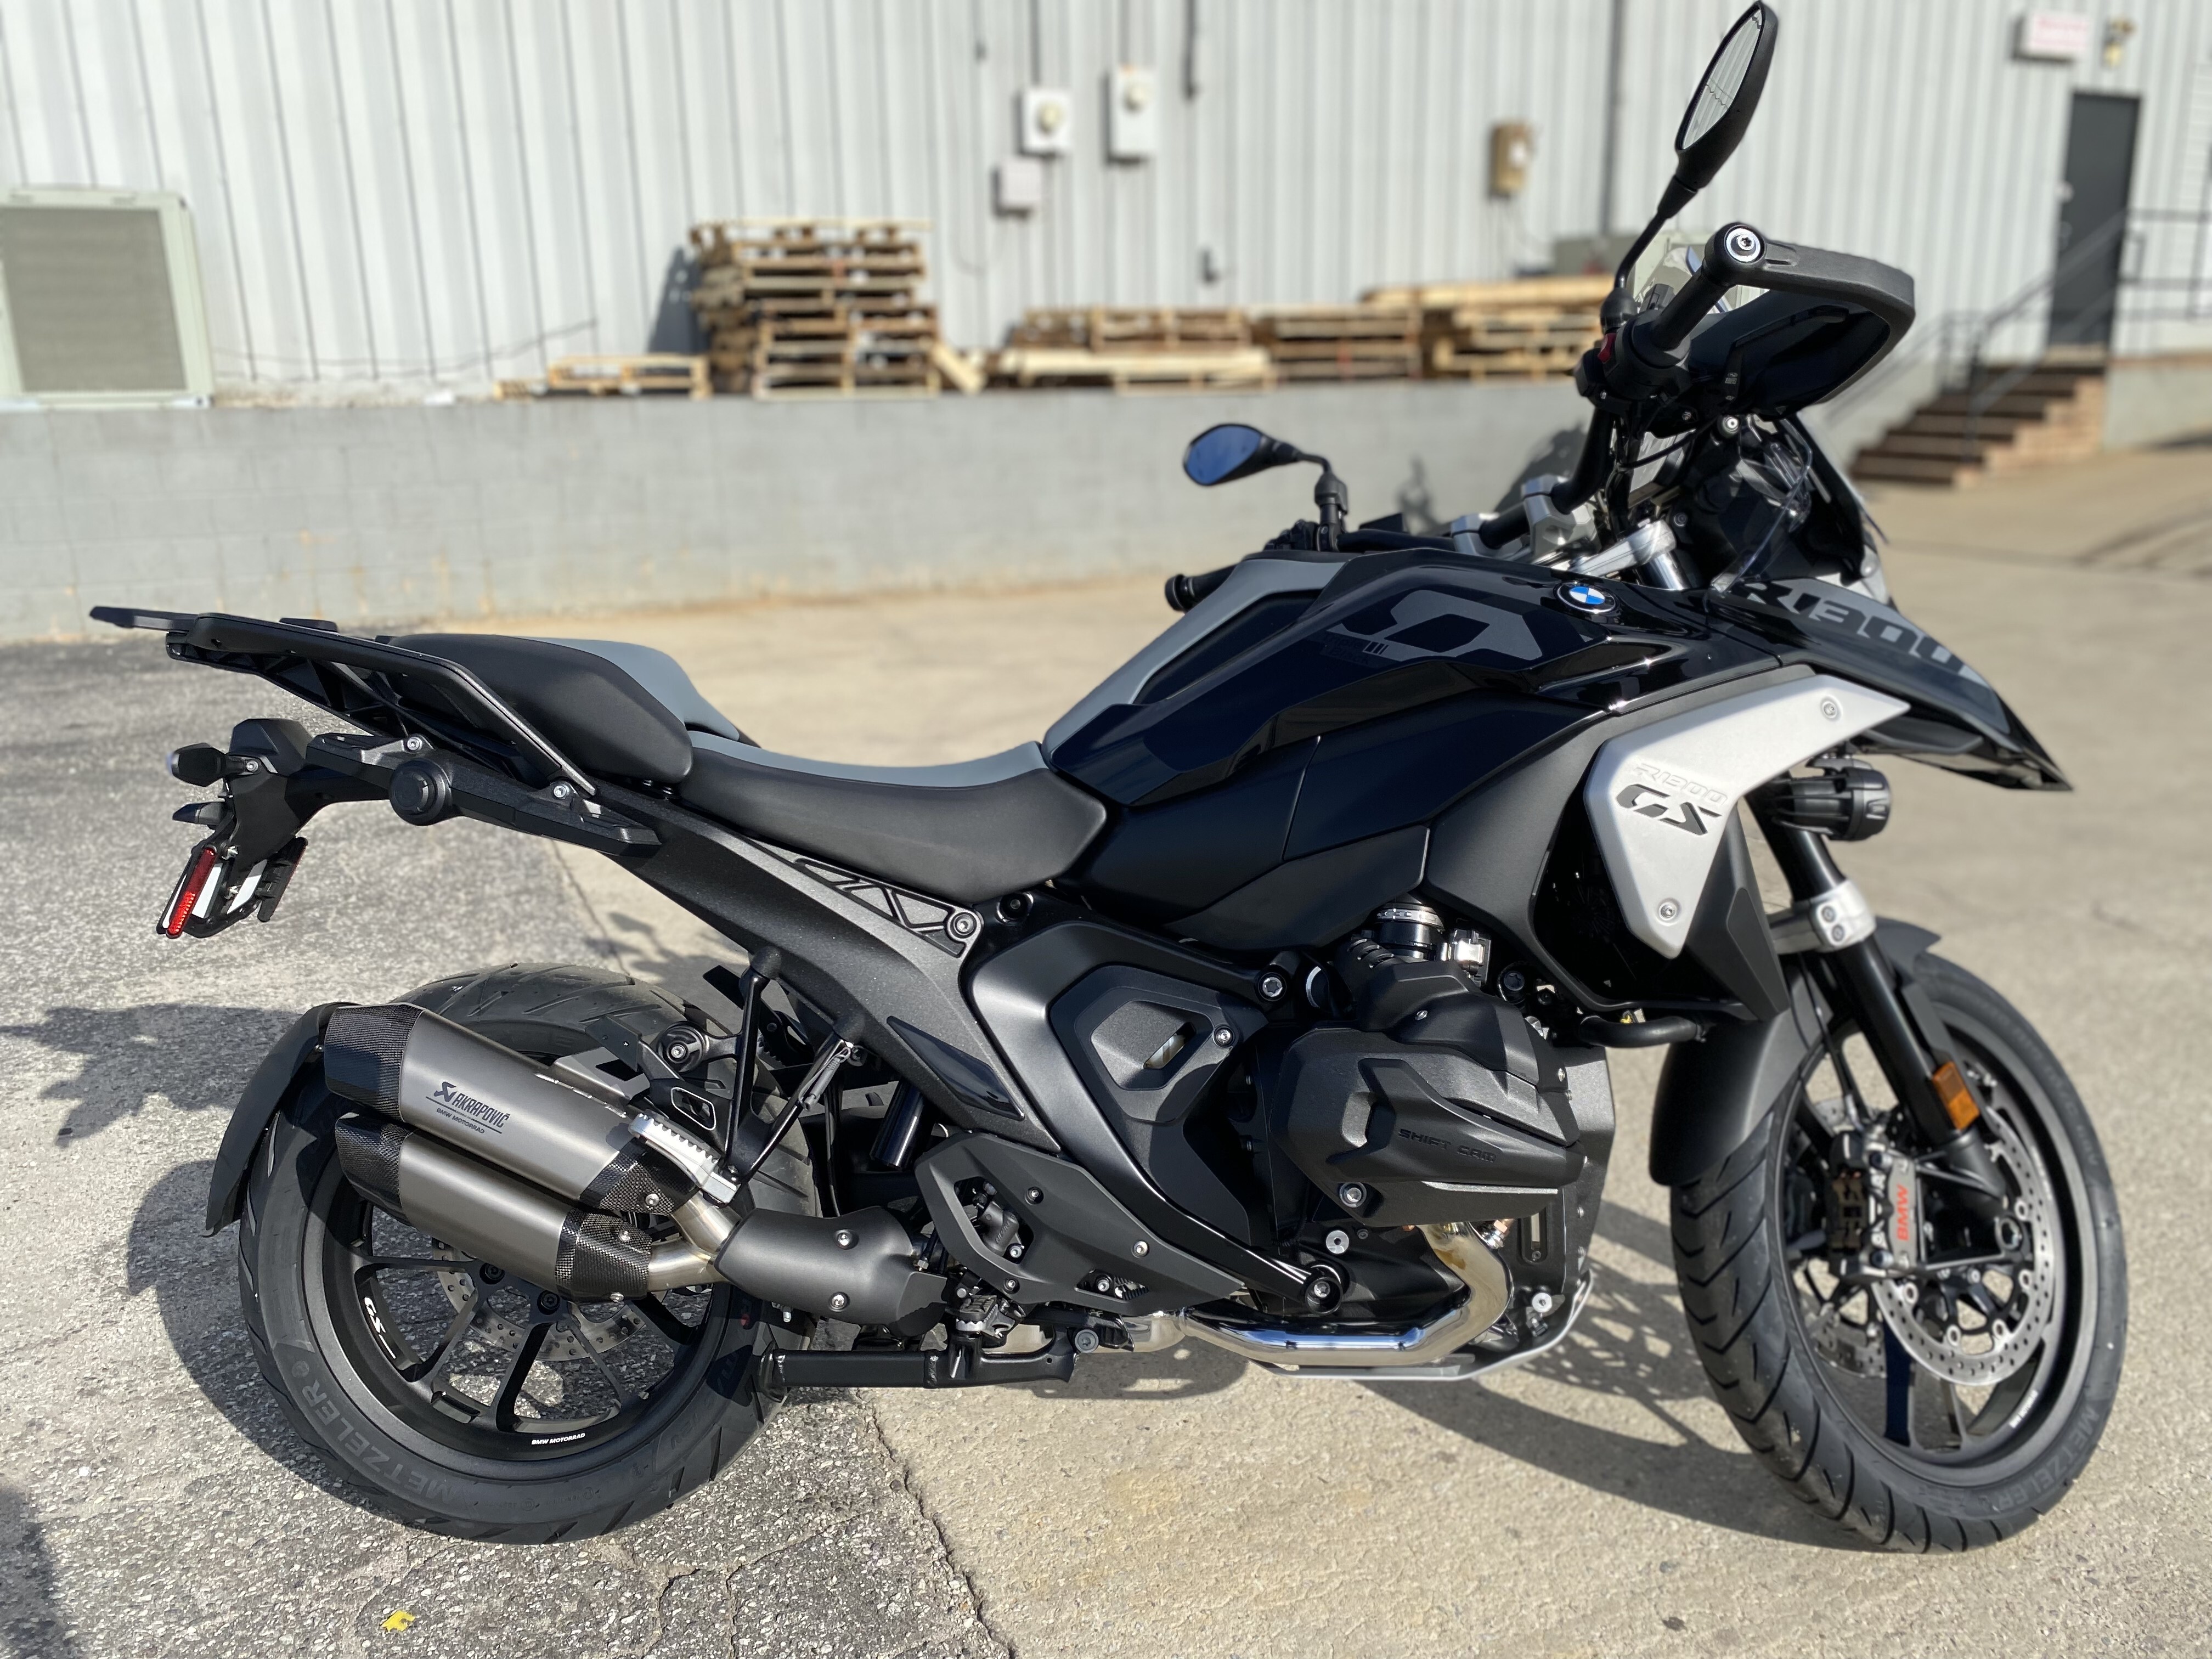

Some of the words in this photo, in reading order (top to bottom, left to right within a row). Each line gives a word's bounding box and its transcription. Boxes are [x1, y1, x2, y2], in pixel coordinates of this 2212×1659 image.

[1615, 783, 1722, 836] GS
[436, 1108, 453, 1119] BMW
[452, 1115, 485, 1135] MOTORRAD
[1398, 1128, 1452, 1150] SHIFT
[1457, 1144, 1497, 1164] CAM
[1896, 1183, 1910, 1241] BMW
[302, 1380, 456, 1503] METZELER
[549, 1432, 586, 1444] MOTORRAD
[1997, 1406, 2100, 1510] METZELER
